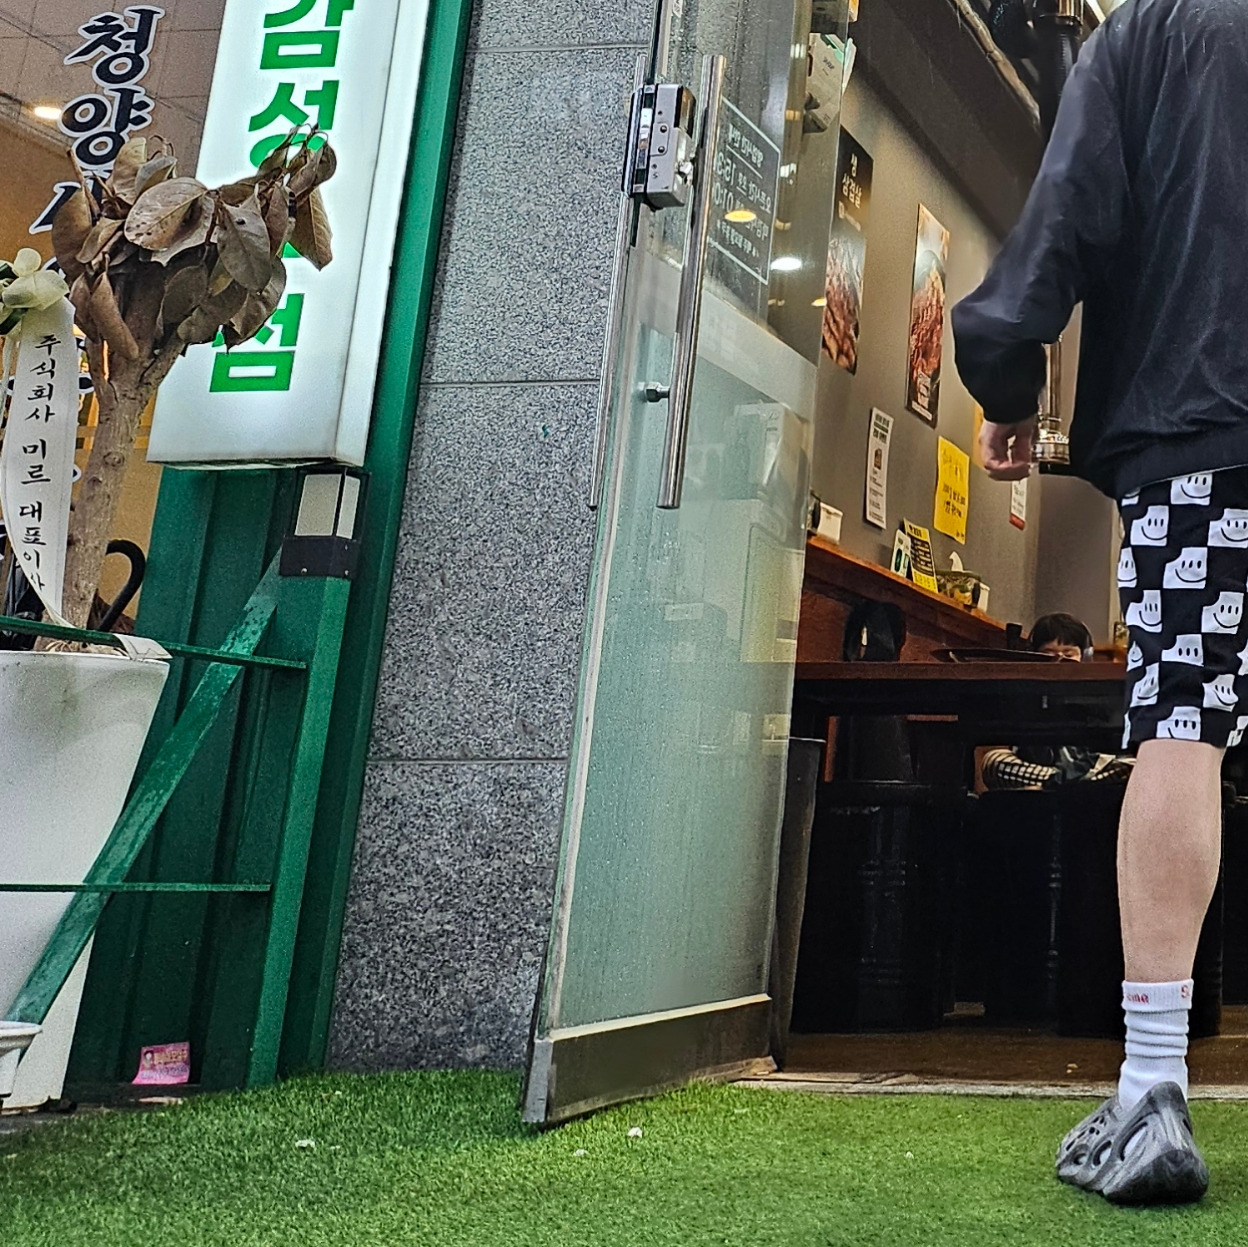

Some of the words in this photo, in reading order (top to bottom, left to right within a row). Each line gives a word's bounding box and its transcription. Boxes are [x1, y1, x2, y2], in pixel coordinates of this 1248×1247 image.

[25, 334, 62, 424] 주식회사
[21, 438, 51, 485] 미르
[19, 500, 47, 591] 대표이사
